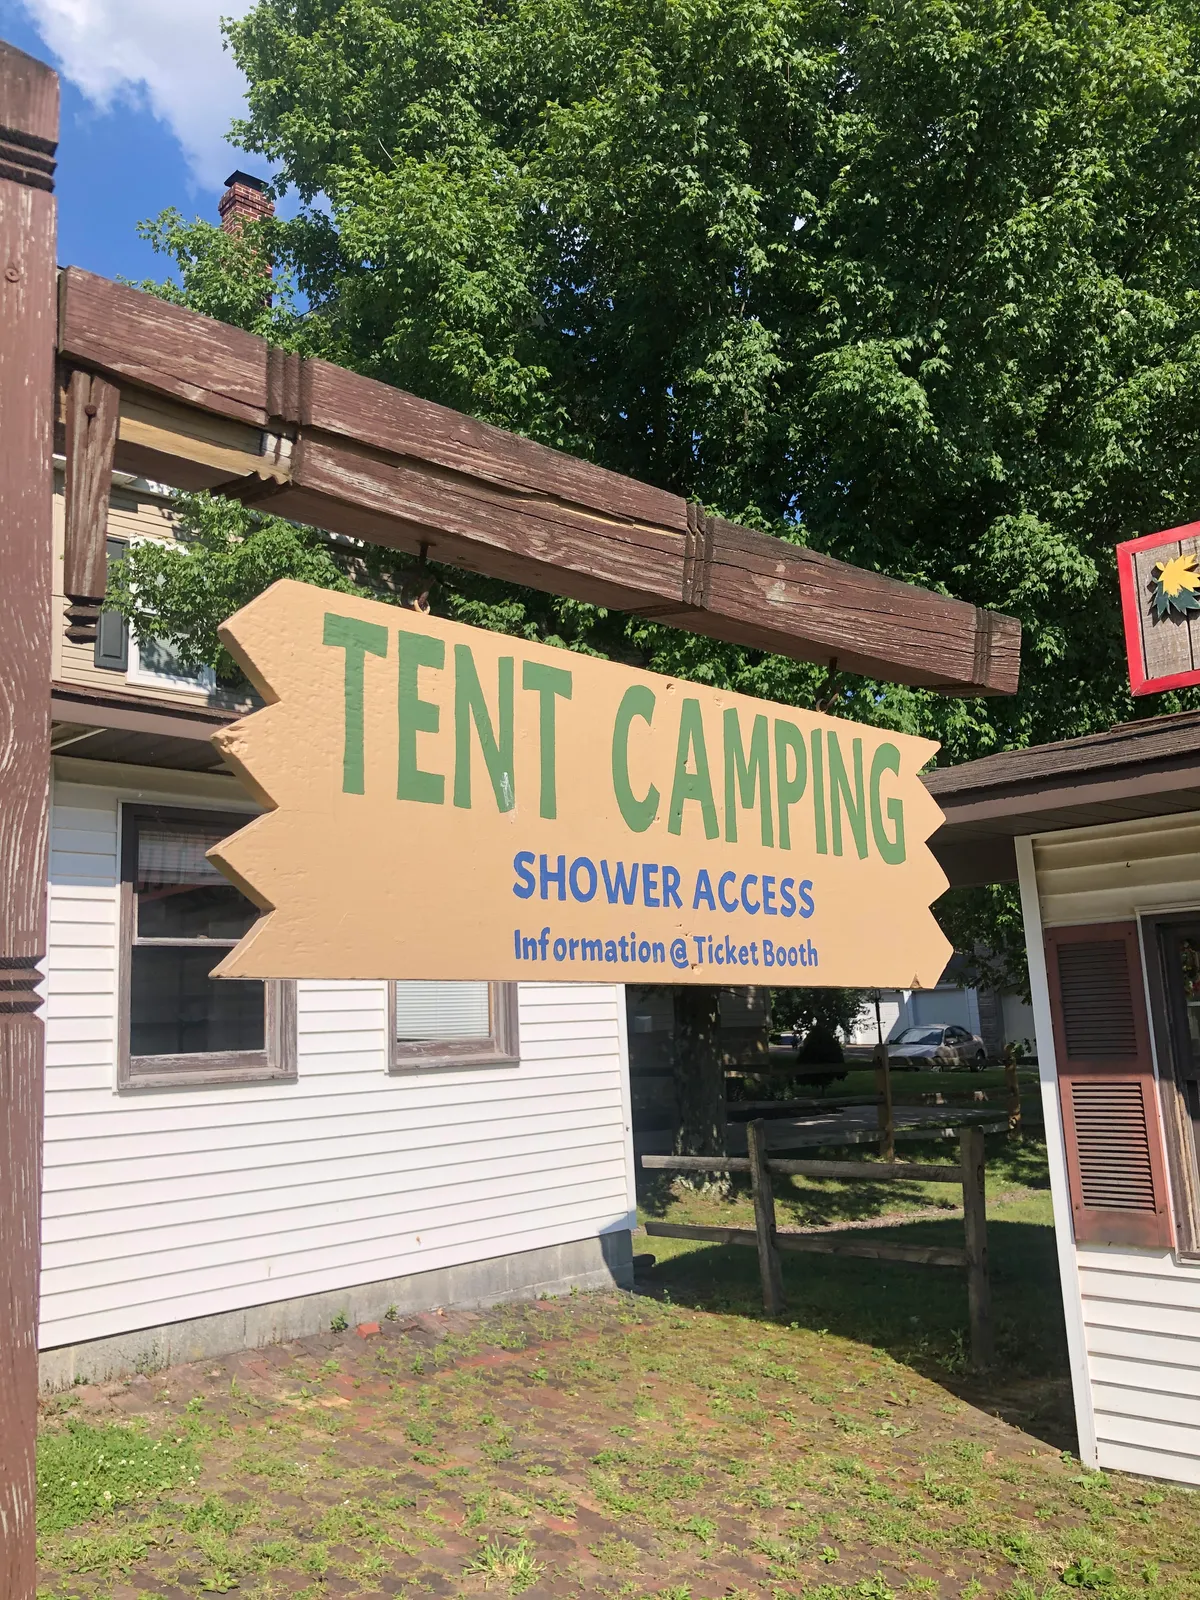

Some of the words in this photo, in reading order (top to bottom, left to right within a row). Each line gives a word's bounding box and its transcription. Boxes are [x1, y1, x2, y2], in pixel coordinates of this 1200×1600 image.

[323, 612, 572, 820] TENT
[612, 684, 906, 865] CAMPING
[512, 851, 683, 909] SHOWER
[692, 869, 815, 919] ACCESS
[514, 926, 665, 963] Information
[669, 938, 689, 969] @
[693, 934, 759, 967] Ticket
[763, 938, 819, 967] Booth
